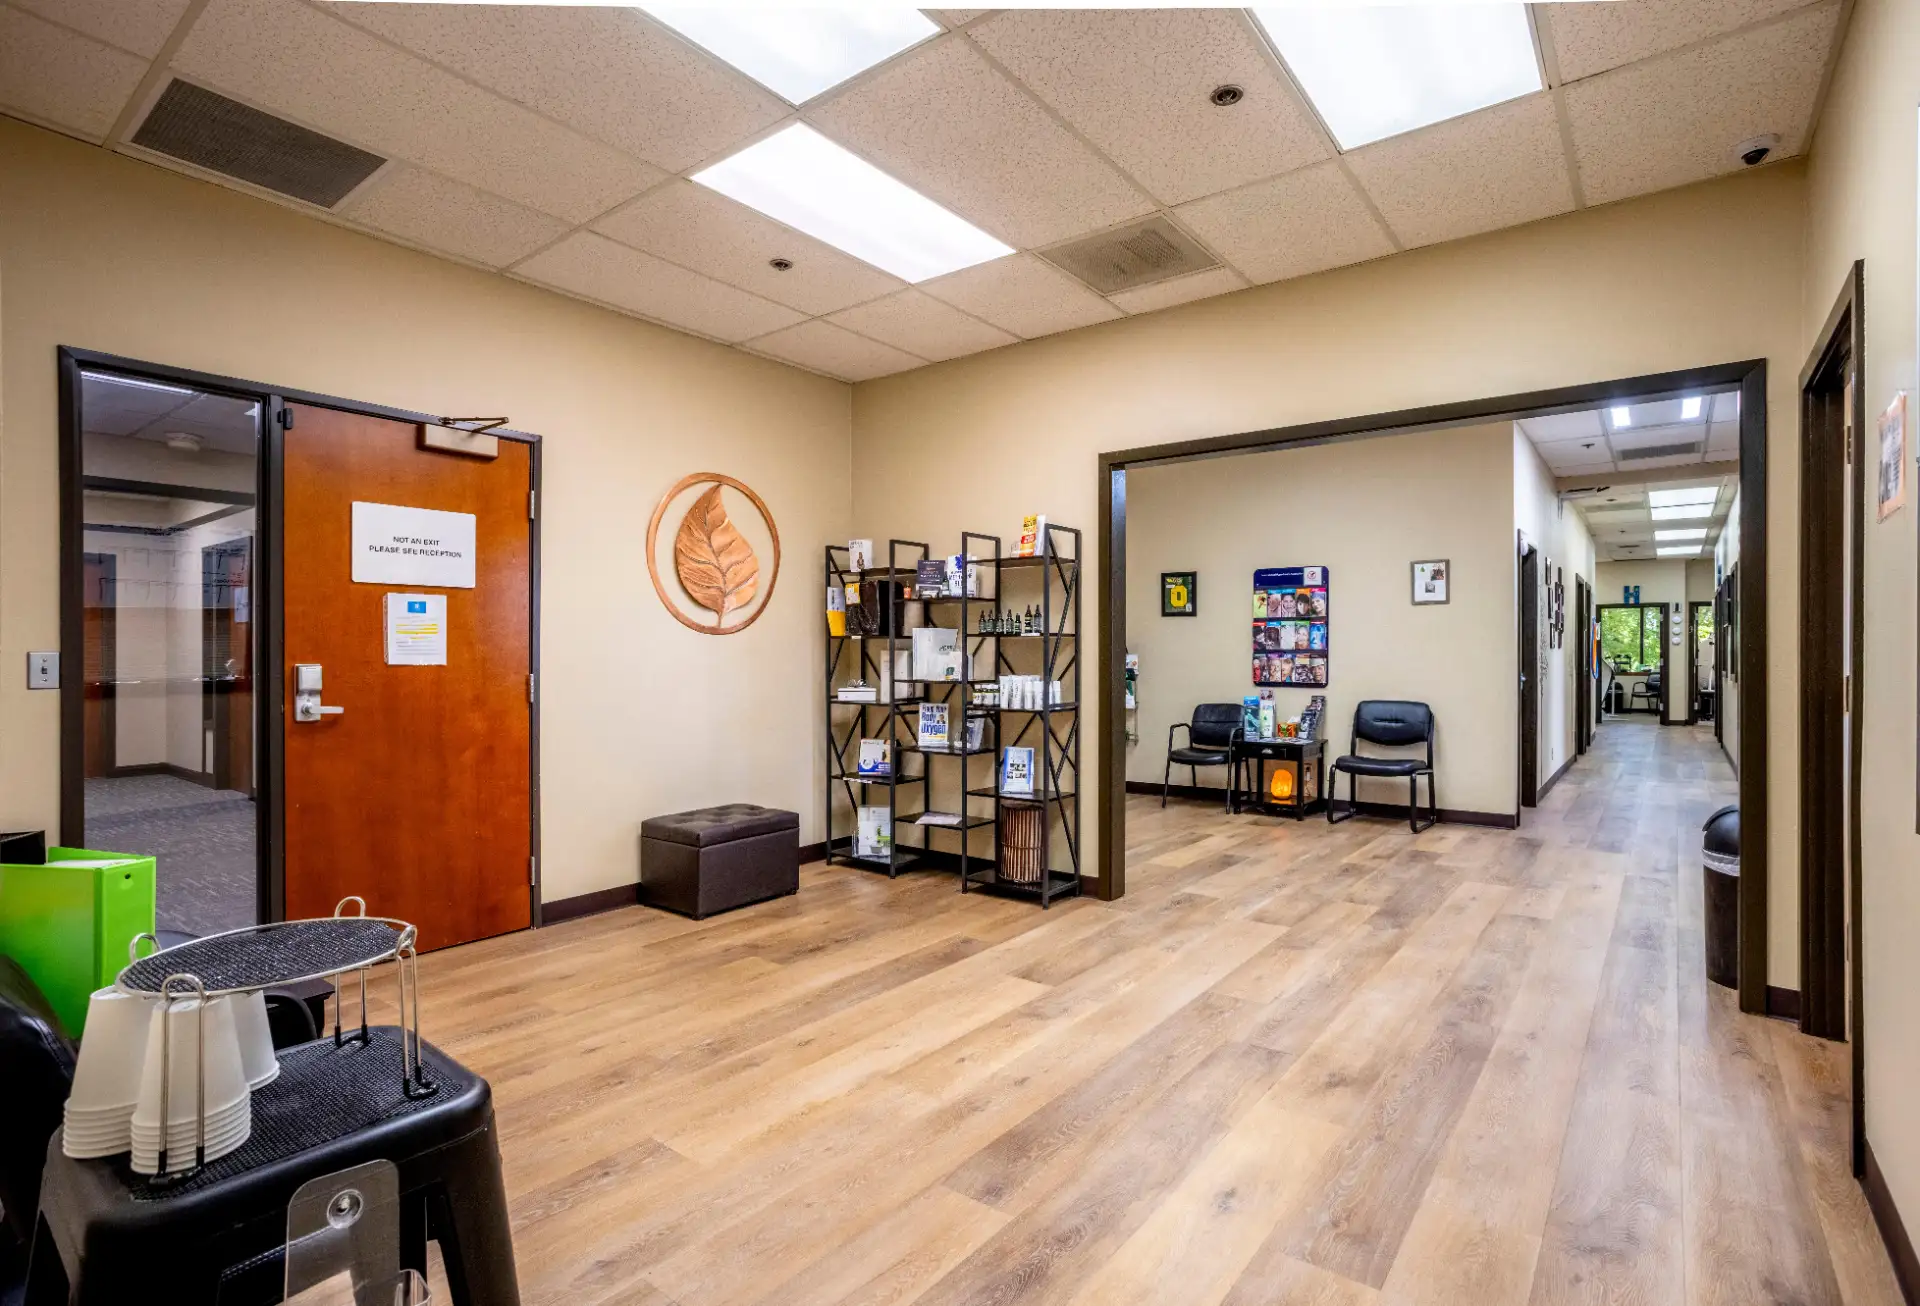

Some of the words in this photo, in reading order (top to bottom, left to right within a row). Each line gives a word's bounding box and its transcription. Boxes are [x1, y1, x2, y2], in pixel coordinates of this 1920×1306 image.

[393, 536, 409, 544] NOT
[369, 545, 401, 554] PLEASE
[402, 547, 418, 555] SEE
[419, 549, 462, 558] RECEPTION
